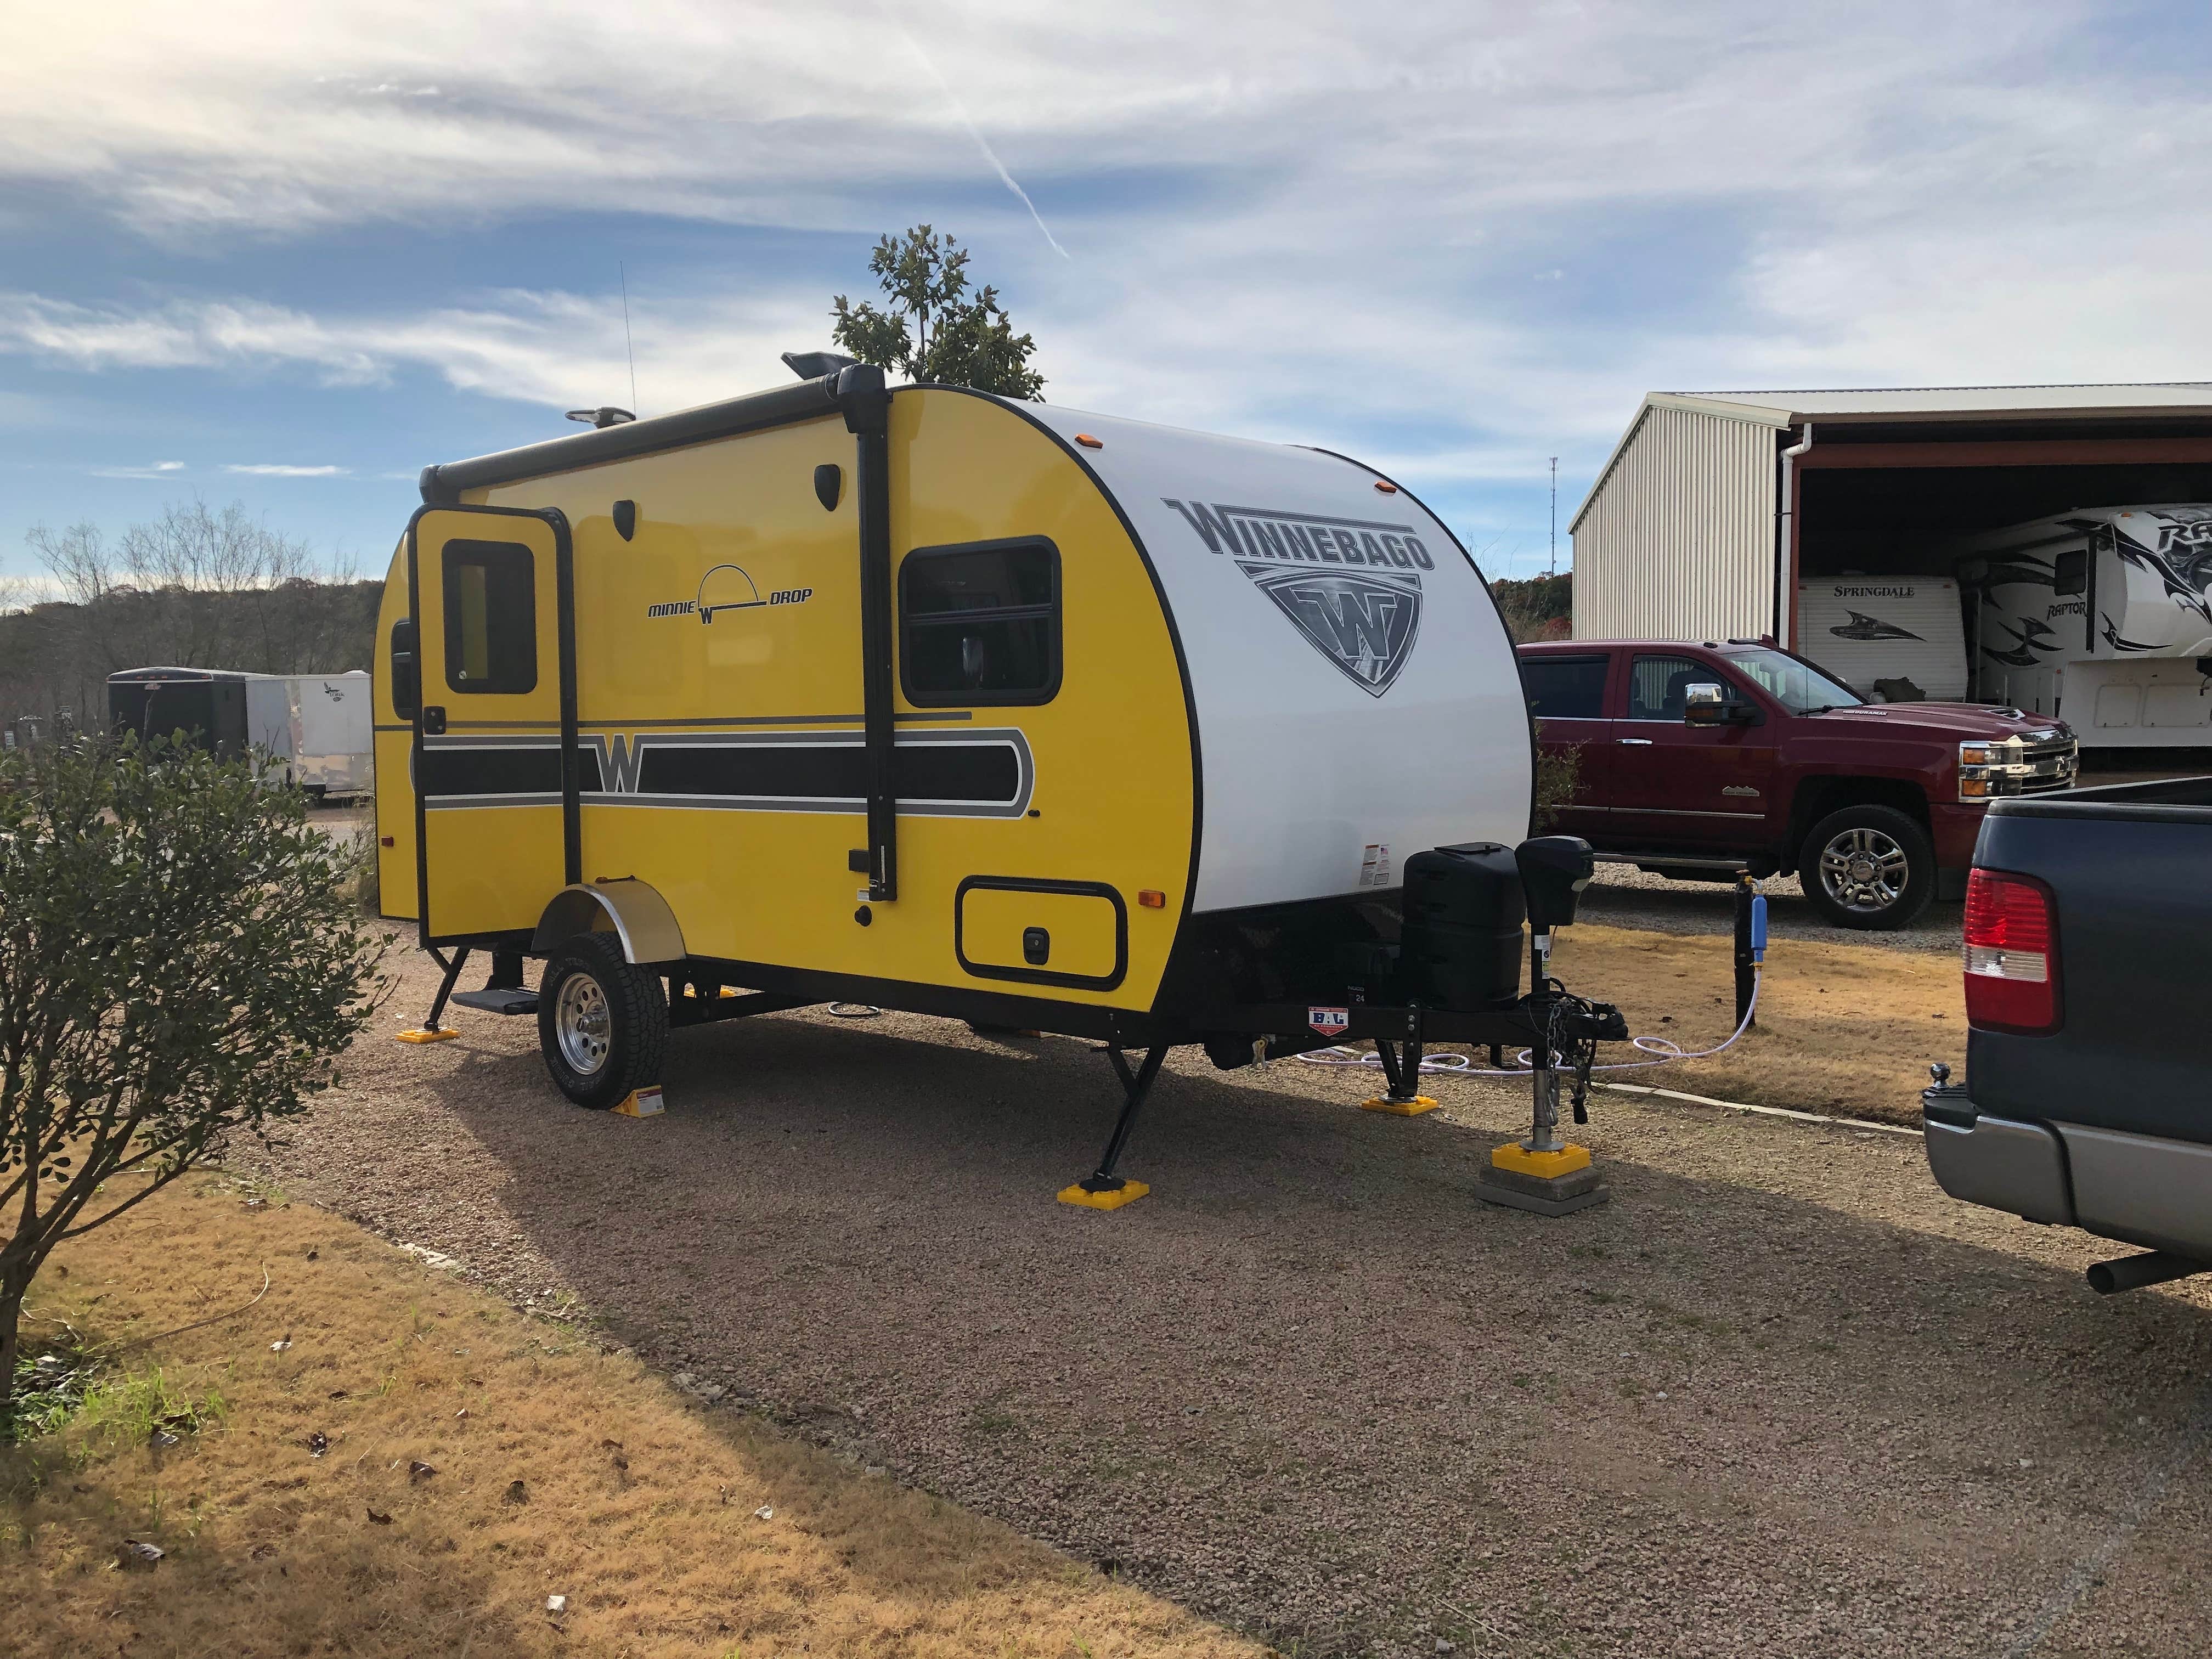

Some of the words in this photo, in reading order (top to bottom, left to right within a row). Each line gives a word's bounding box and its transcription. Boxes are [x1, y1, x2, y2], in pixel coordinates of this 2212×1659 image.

[1160, 497, 1435, 571] WINNEBAGO
[1833, 586, 1915, 597] SPRINGDALE
[647, 601, 696, 618] MINNIE
[769, 588, 812, 606] DROP
[2046, 602, 2087, 622] RAPTOR
[1290, 588, 1398, 659] W
[1356, 994, 1365, 1002] 24
[1313, 1012, 1344, 1025] BAL
